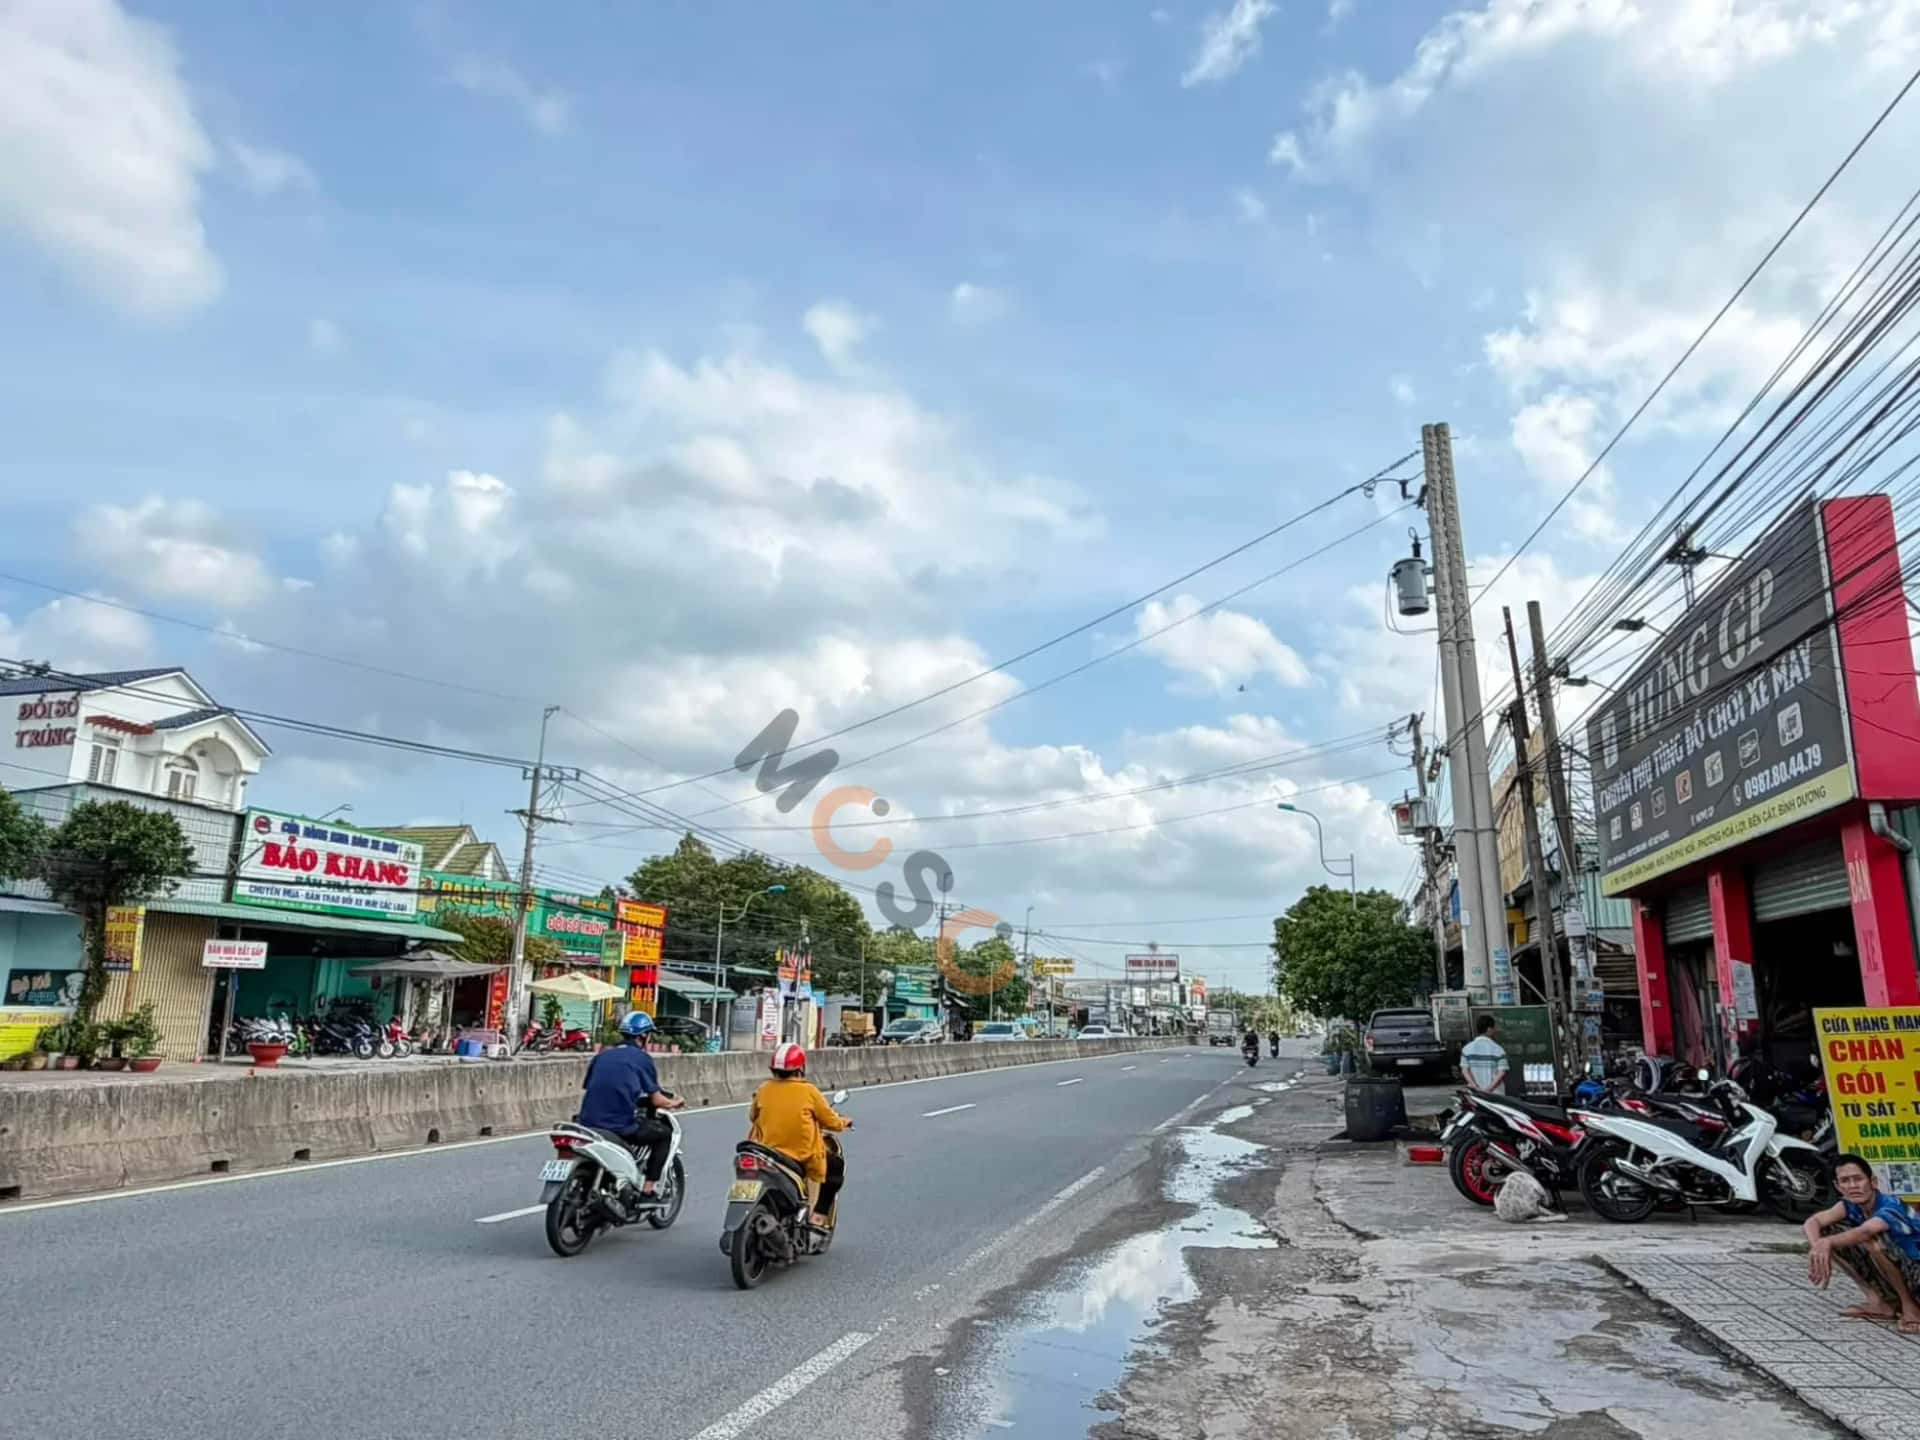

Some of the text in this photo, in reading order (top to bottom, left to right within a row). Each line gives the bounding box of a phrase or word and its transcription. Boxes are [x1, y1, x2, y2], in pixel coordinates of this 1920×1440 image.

[1718, 567, 1775, 671] GP
[1747, 671, 1770, 717] XE
[1743, 743, 1822, 799] 0987.80.44.79
[260, 835, 409, 887] BẢO KHANG
[1822, 1014, 1849, 1033] CỬA
[1828, 1035, 1905, 1063] CHĂN
[1836, 1064, 1887, 1096] GỐI
[1841, 1099, 1862, 1118] TỦ
[1866, 1098, 1896, 1117] SẮT
[1895, 1122, 1920, 1140] HỌ
[1862, 1144, 1880, 1159] GIA
